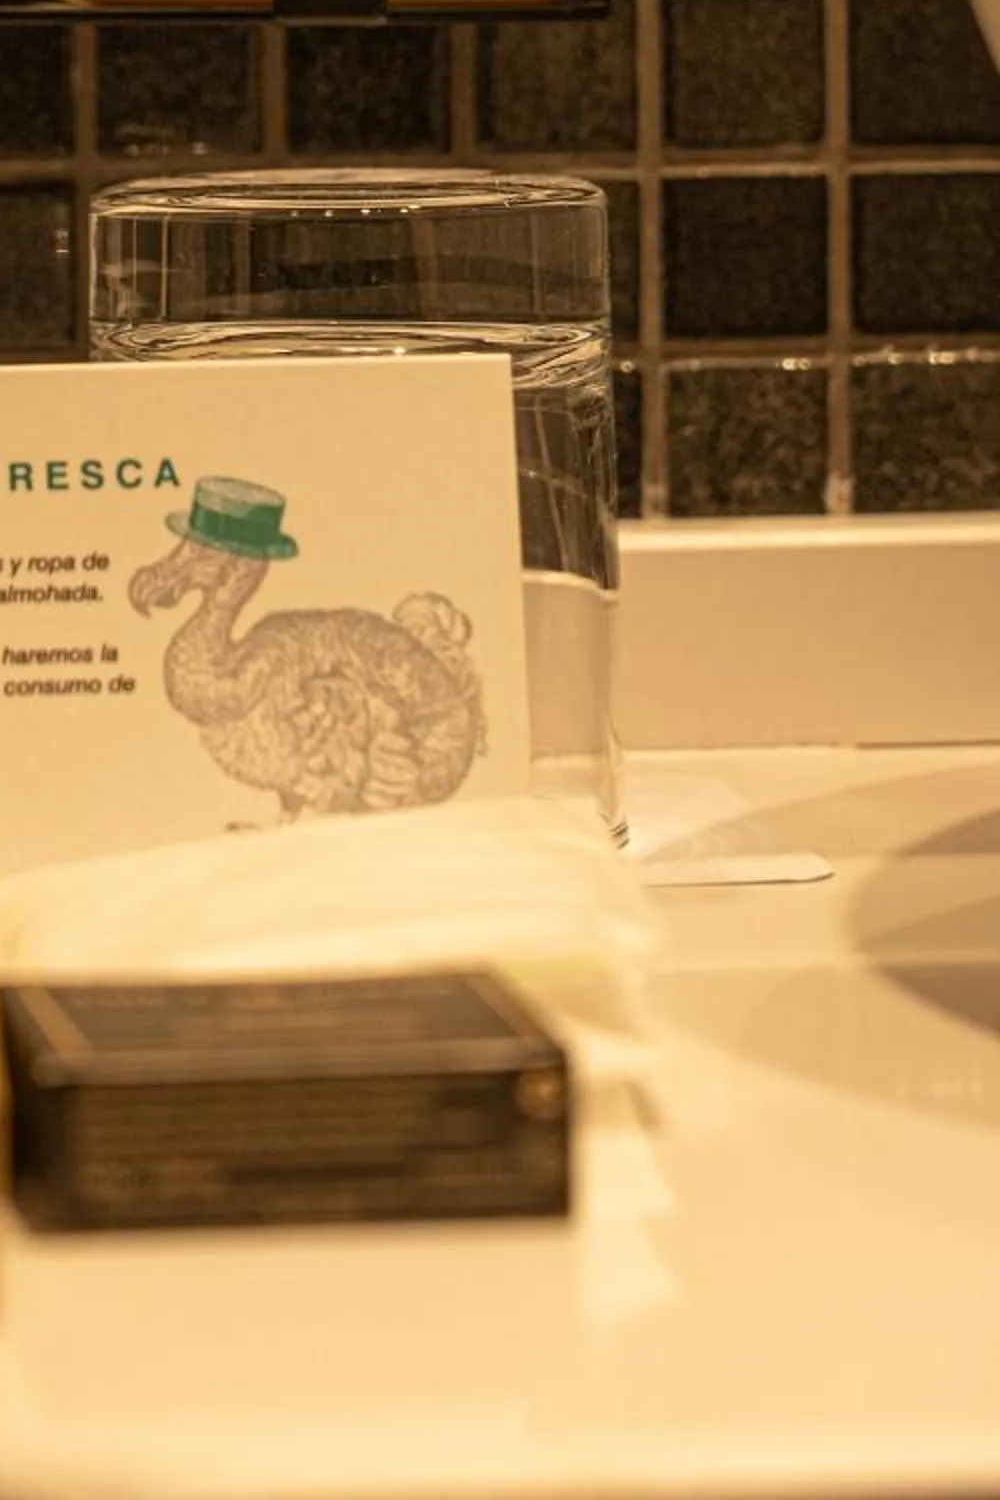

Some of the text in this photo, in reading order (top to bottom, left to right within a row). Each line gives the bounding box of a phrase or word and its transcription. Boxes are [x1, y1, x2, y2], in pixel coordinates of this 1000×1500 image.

[10, 557, 22, 577] y
[28, 554, 75, 574] ropa
[82, 551, 110, 571] de
[1, 645, 93, 666] haremos
[101, 643, 119, 663] la
[3, 676, 102, 697] consumo
[108, 673, 136, 695] de
